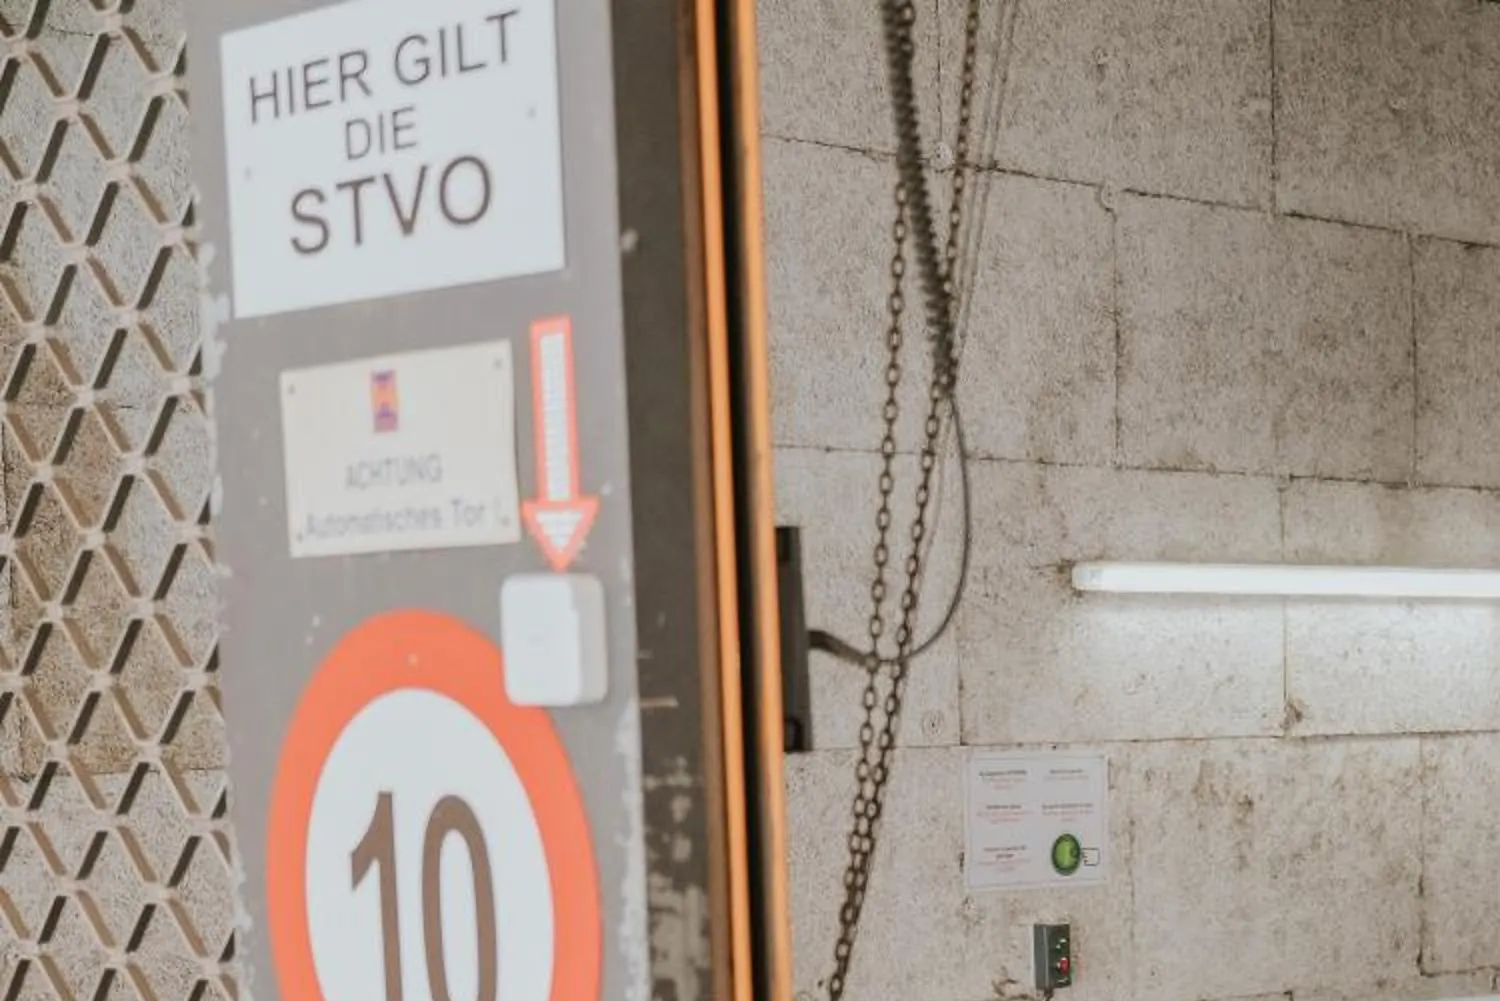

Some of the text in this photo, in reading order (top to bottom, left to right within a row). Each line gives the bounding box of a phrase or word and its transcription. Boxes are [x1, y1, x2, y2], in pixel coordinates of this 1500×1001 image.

[249, 9, 519, 125] HIER GILT
[344, 106, 418, 161] DIE
[289, 154, 493, 256] STVO
